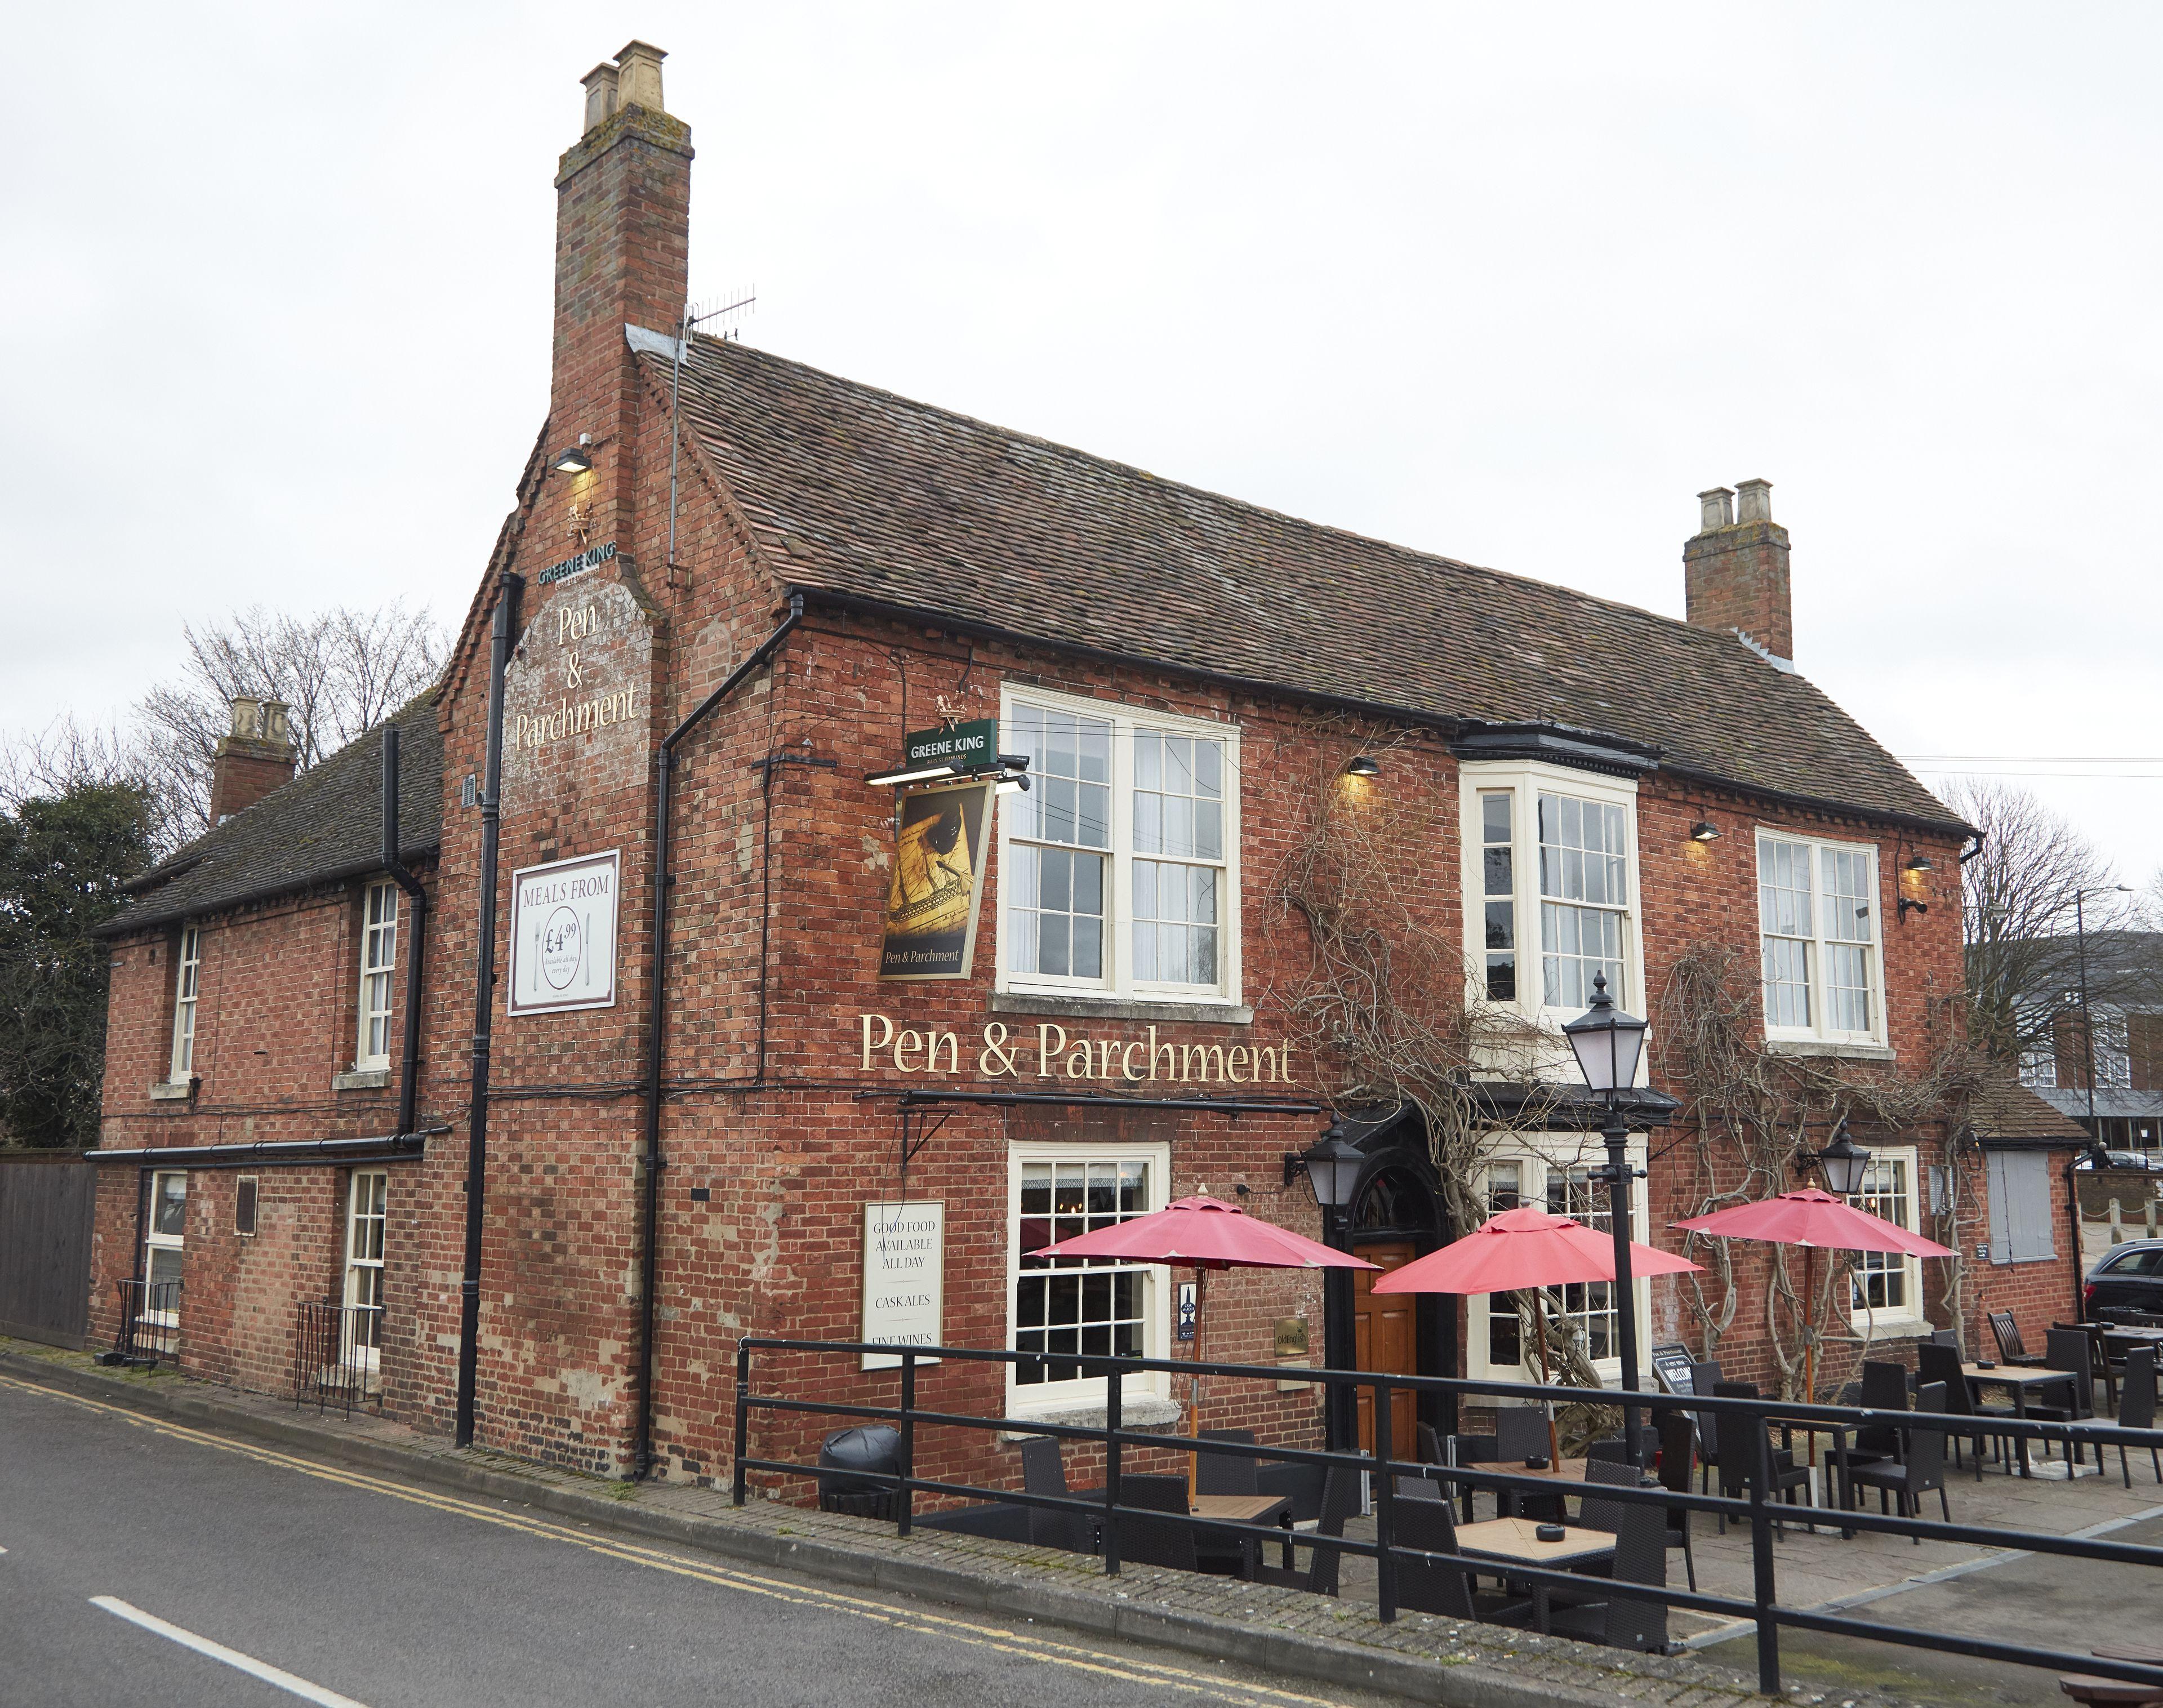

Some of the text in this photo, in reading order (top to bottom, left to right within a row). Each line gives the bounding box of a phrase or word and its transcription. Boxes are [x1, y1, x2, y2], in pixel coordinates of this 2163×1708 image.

[538, 541, 615, 584] GREENE KING
[575, 568, 598, 581] EDMUNDS
[558, 604, 597, 646] Pen
[567, 652, 583, 690] &
[516, 682, 639, 751] Parchment
[911, 735, 984, 759] GREENE KING
[523, 874, 609, 908] MEALS FROM
[544, 955, 563, 965] Available
[885, 949, 959, 963] Pen & Parchment
[858, 1014, 1298, 1084] Pen & Parchment
[873, 1220, 935, 1234] GOOD FOOD
[875, 1238, 932, 1252] AVAILABLE
[882, 1256, 925, 1269] ALL DAY
[875, 1294, 931, 1309] CASK ALES
[872, 1332, 932, 1345] FINE WINES
[1278, 1333, 1306, 1345] OldEnglish
[1664, 1367, 1692, 1382] WELCOM
